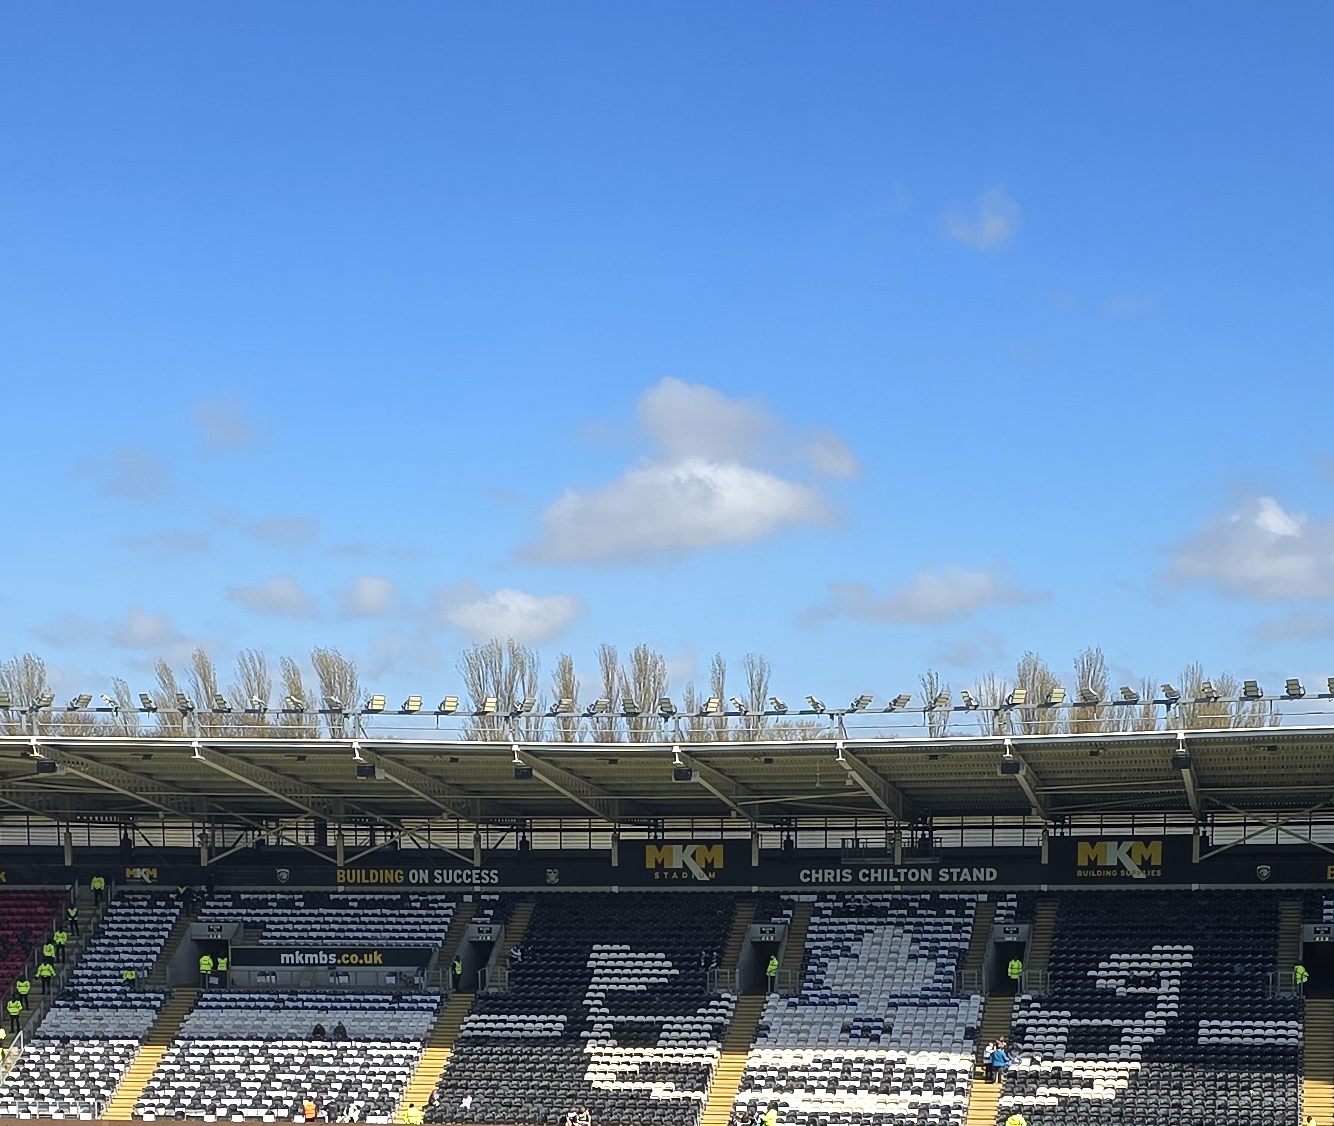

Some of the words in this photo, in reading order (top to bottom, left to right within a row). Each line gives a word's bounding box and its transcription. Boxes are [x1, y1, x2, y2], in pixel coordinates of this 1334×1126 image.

[646, 844, 724, 880] MKM
[1077, 841, 1162, 878] MKM
[125, 868, 158, 884] MKM
[336, 869, 404, 884] BUILDING
[409, 869, 429, 884] ON
[434, 869, 499, 884] SUCCESS
[799, 869, 852, 883] CHRIS
[859, 868, 933, 883] CHILTON
[939, 868, 998, 882] STAND
[1077, 869, 1117, 877] BUILDING
[280, 949, 382, 965] mkmbs.co.uk
